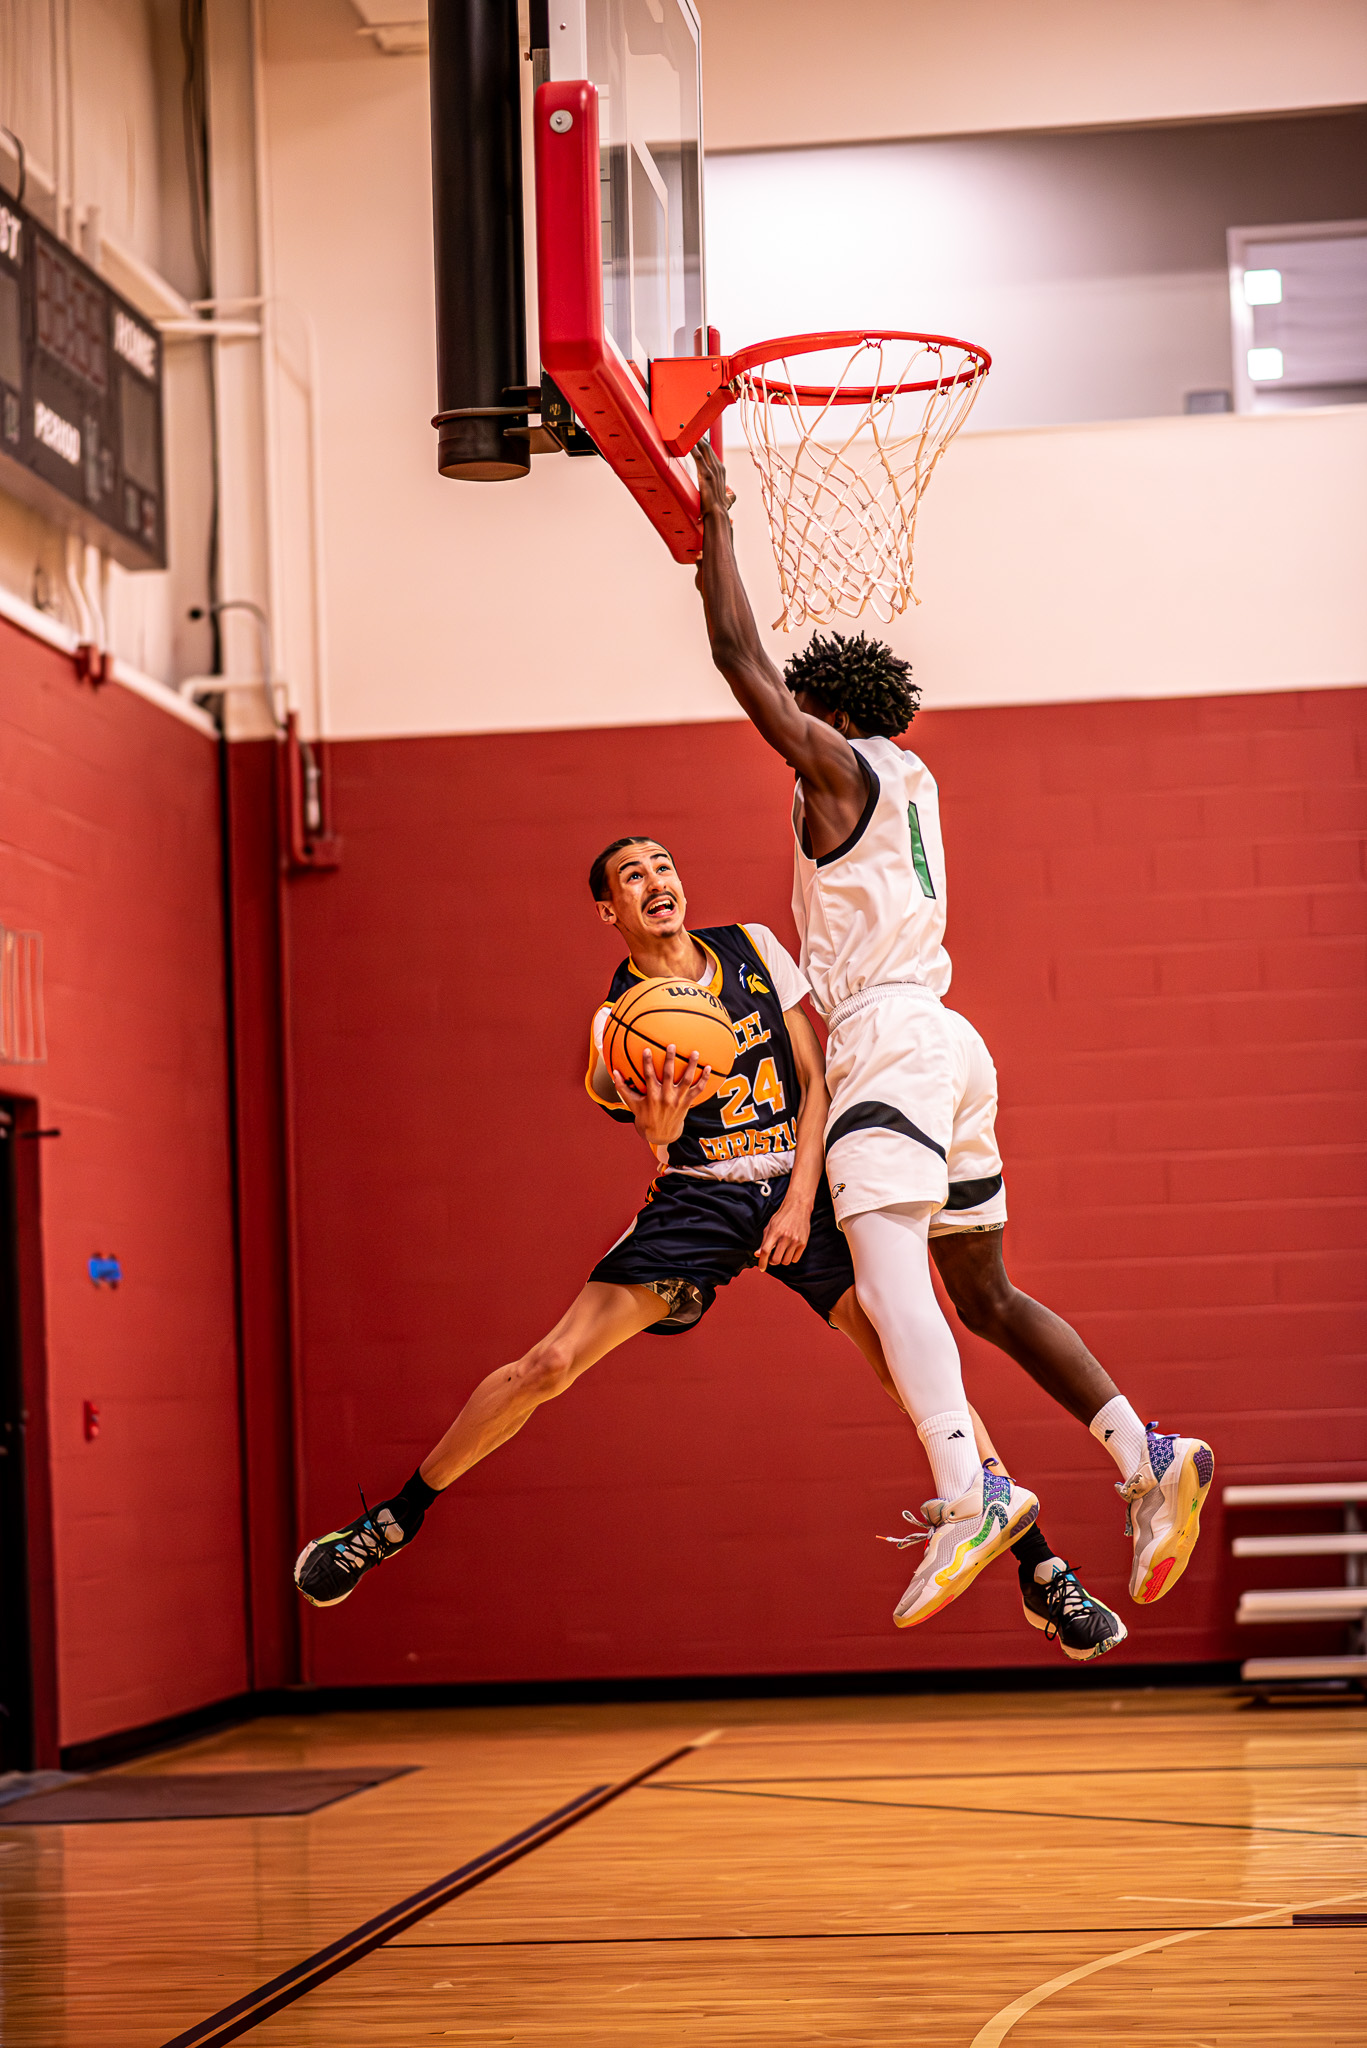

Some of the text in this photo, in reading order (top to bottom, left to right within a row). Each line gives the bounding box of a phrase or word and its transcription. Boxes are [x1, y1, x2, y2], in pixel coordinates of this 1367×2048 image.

[34, 400, 81, 465] PERIOD
[907, 800, 937, 899] 1
[733, 1010, 771, 1058] CEL
[717, 1056, 786, 1129] 24
